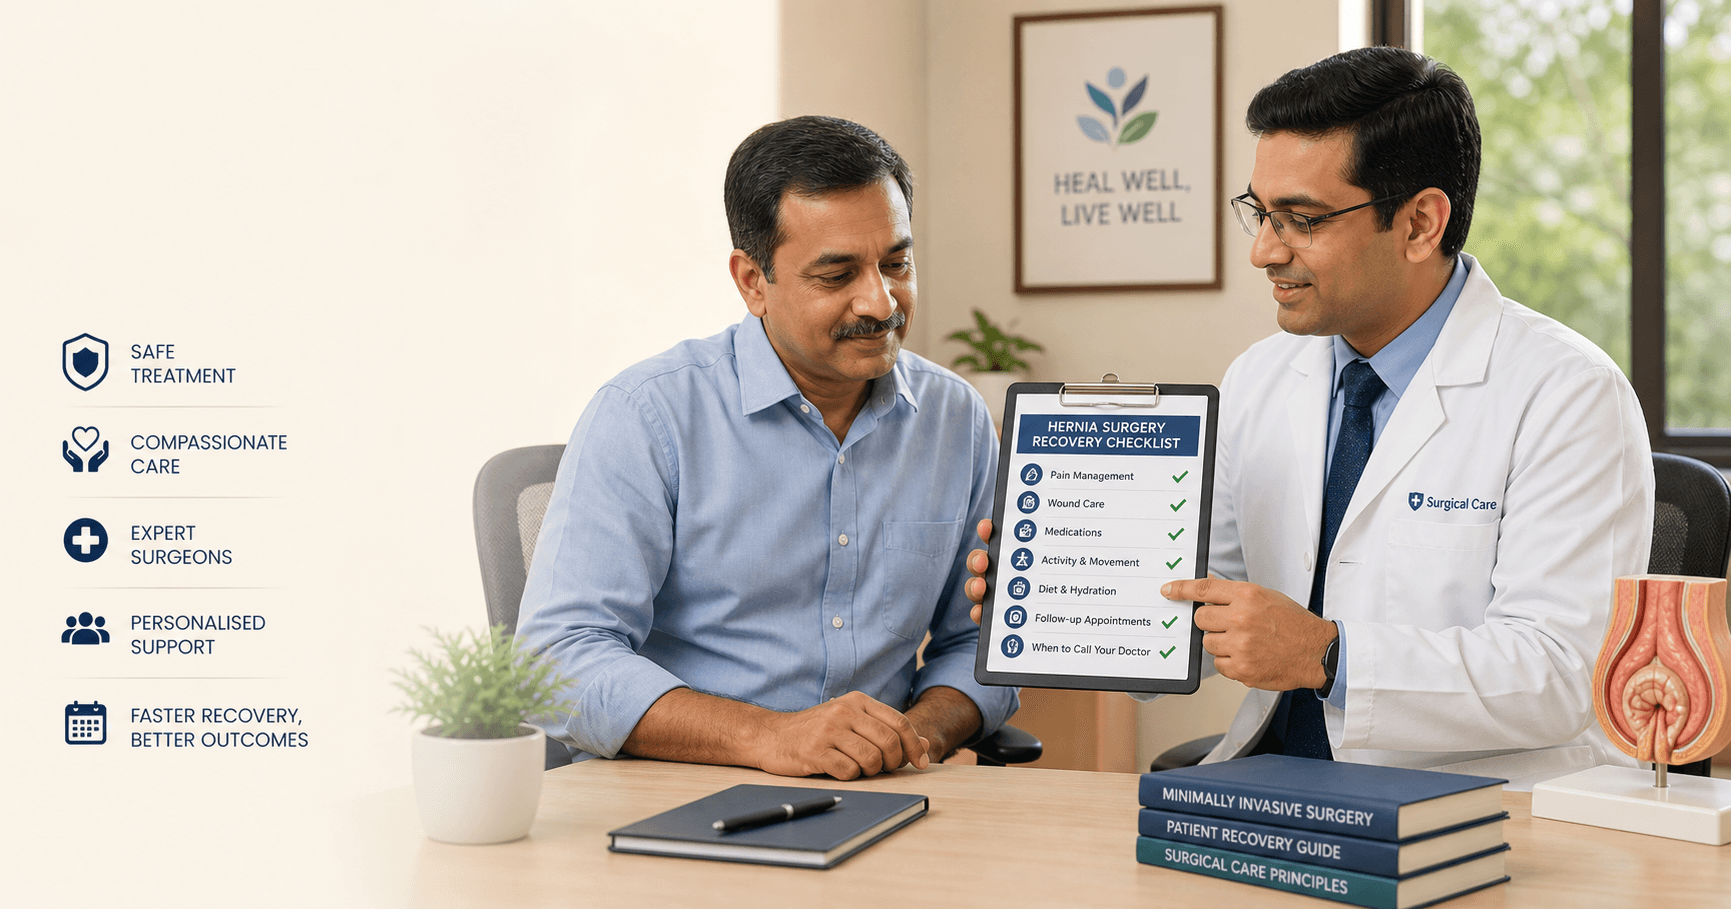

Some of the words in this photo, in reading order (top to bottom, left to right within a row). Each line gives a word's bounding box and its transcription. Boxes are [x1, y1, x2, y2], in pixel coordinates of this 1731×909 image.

[1054, 171, 1115, 194] HEAL
[1121, 168, 1191, 193] WELL,
[1061, 202, 1110, 226] LIVE
[1118, 201, 1182, 224] WELL
[1048, 421, 1098, 433] HERNIA
[1103, 422, 1165, 433] SURGERY
[1033, 436, 1102, 448] RECOVERY
[1106, 437, 1180, 449] CHECKLIST
[1051, 471, 1071, 480] Pain
[1073, 471, 1134, 482] Management
[1048, 499, 1080, 508] Wound
[1083, 500, 1104, 508] Care
[1427, 497, 1468, 511] Surgical
[1472, 499, 1497, 510] Care
[1045, 527, 1102, 537] Medications
[1041, 556, 1077, 567] Activity
[1080, 557, 1087, 566] &
[1090, 557, 1139, 567] Movement
[1039, 585, 1058, 594] Diet
[1060, 586, 1068, 594] &
[1070, 586, 1116, 597] Hydration
[1035, 614, 1081, 626] Follow-up
[1084, 615, 1151, 628] Appointments
[1032, 643, 1059, 653] When
[1062, 645, 1071, 653] to
[1074, 644, 1092, 654] Call
[1094, 645, 1115, 654] Your
[1118, 646, 1151, 656] Doctor
[1163, 787, 1235, 808] MINIMALLY
[1239, 797, 1302, 818] INVASIVE
[1306, 805, 1373, 827] SURGERY
[1167, 820, 1218, 840] PATIENT
[1222, 829, 1293, 851] RECOVERY
[1297, 840, 1341, 860] GUIDE
[1165, 848, 1227, 871] SURGICAL
[1231, 860, 1266, 879] CARE
[1270, 868, 1348, 895] PRINCIPLES
